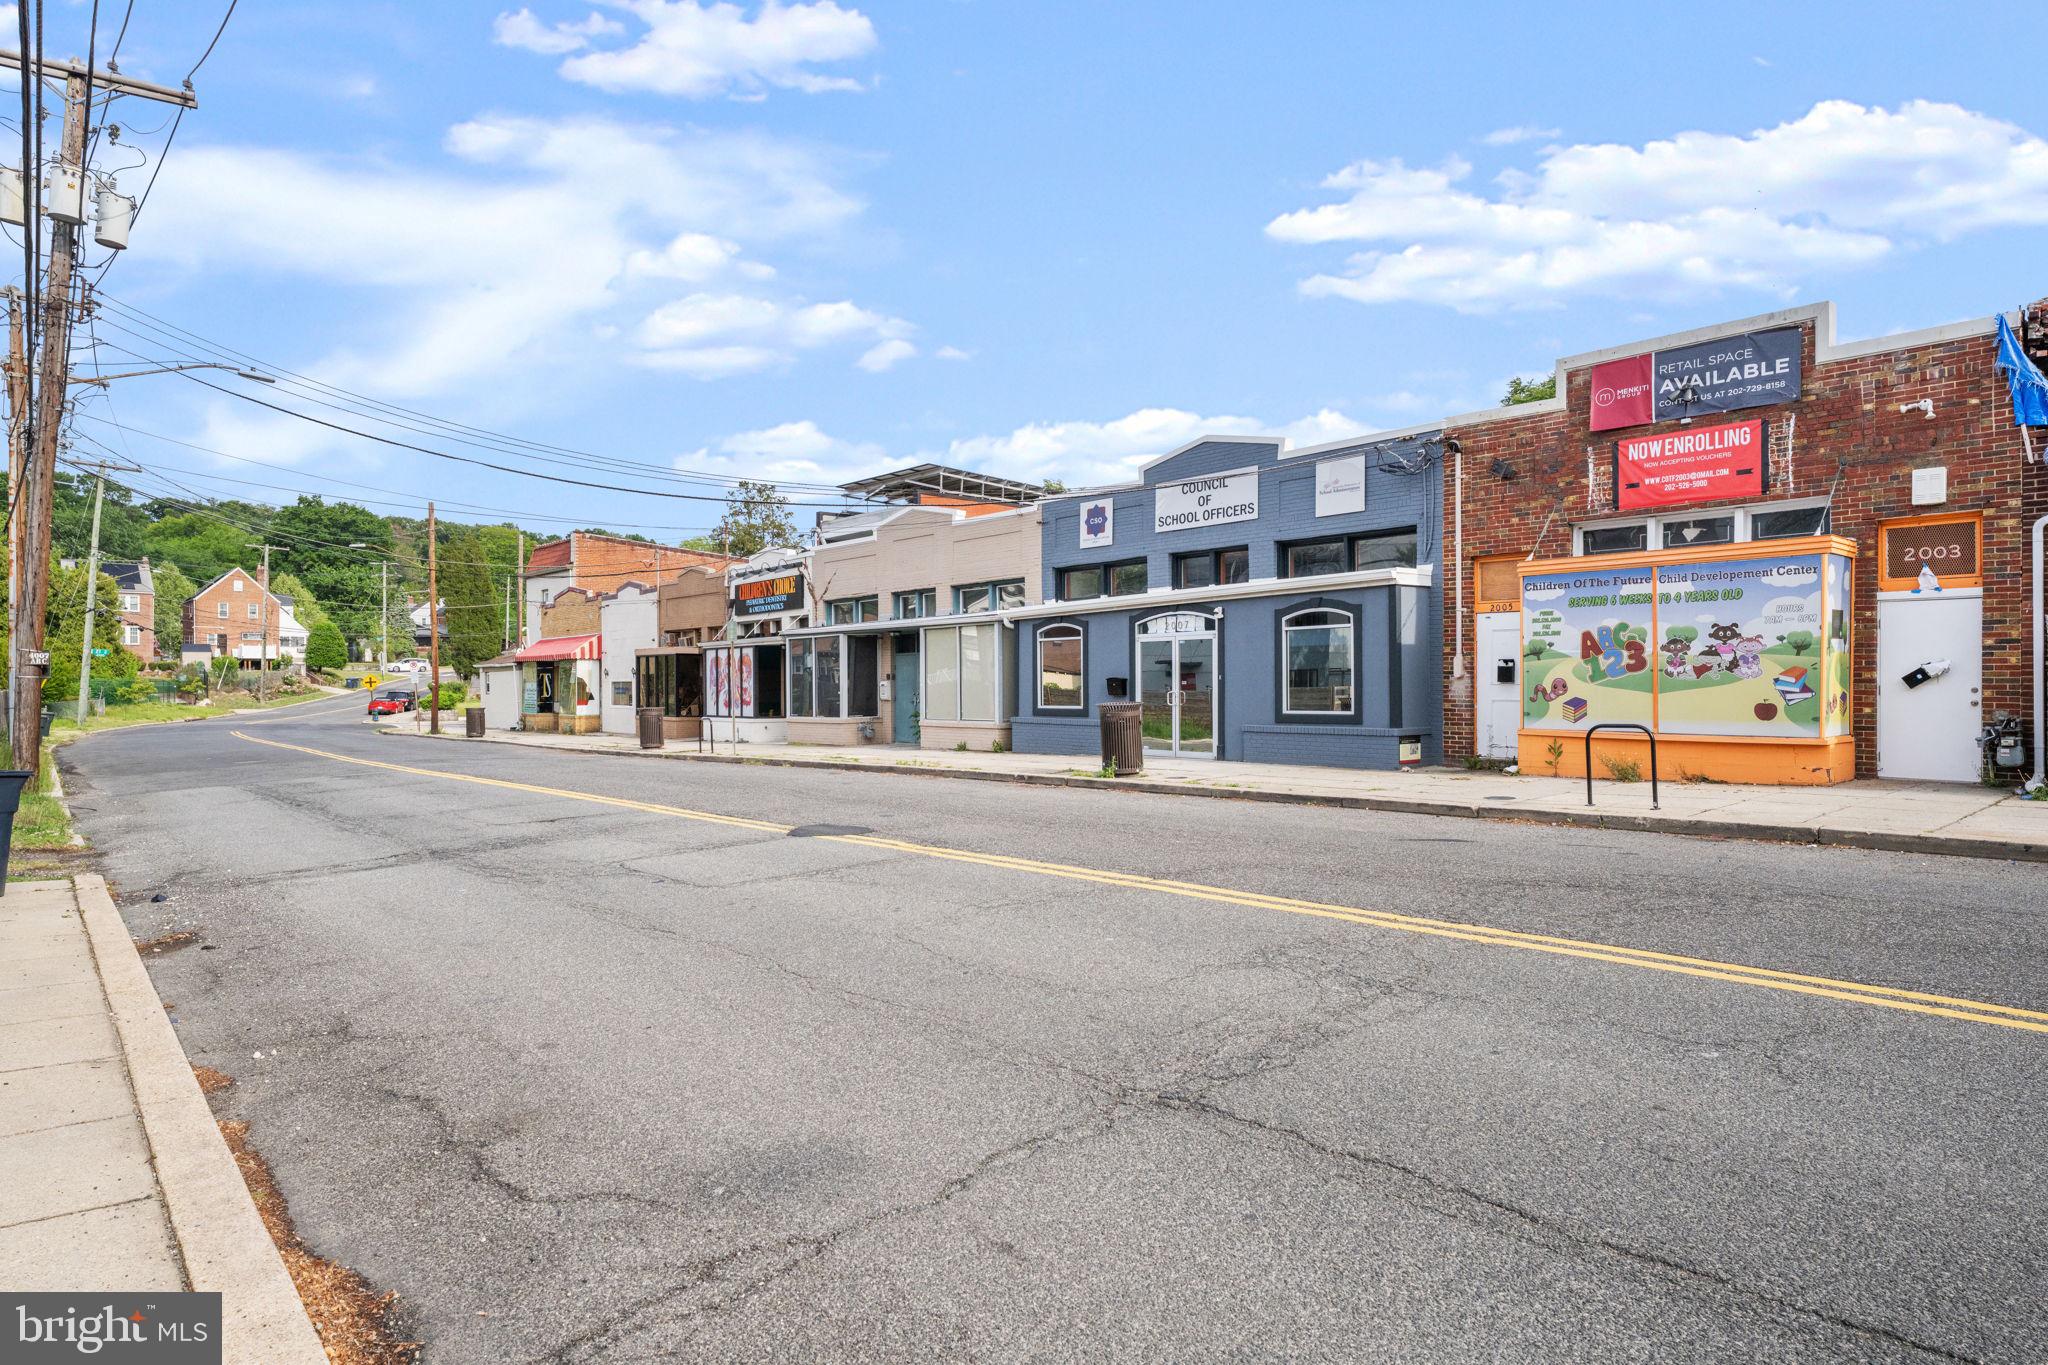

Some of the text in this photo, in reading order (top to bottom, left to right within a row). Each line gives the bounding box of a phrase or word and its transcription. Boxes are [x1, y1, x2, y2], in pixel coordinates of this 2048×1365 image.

[1660, 348, 1753, 374] RETAIL SPACE
[1659, 357, 1790, 394] AVAILABLE
[1617, 384, 1649, 396] MENKITI
[1617, 391, 1641, 400] GROUP
[1700, 392, 1712, 401] US
[1714, 390, 1725, 399] AT
[1728, 380, 1786, 397] 202-729-8158
[1628, 427, 1751, 461] NOW ENROLLING
[1660, 456, 1695, 467] ACCEPTING
[1696, 451, 1732, 461] VOUCHERS
[1181, 478, 1228, 495] COUNCIL
[1197, 494, 1212, 507] OF
[1090, 517, 1103, 525] CSO
[1158, 502, 1255, 527] SCHOOL OFFICERS
[1904, 544, 1961, 561] 2003
[773, 575, 796, 595] CHOICE
[1524, 565, 1819, 592] Children Of The Future Child Developement Center
[1490, 602, 1514, 612] 2005
[1568, 587, 1744, 608] SERVING 6 WEEKS TO 4 YEARS OLD
[1775, 603, 1805, 614] HOURS
[1581, 622, 1631, 660] ABC
[1582, 639, 1648, 684] 123
